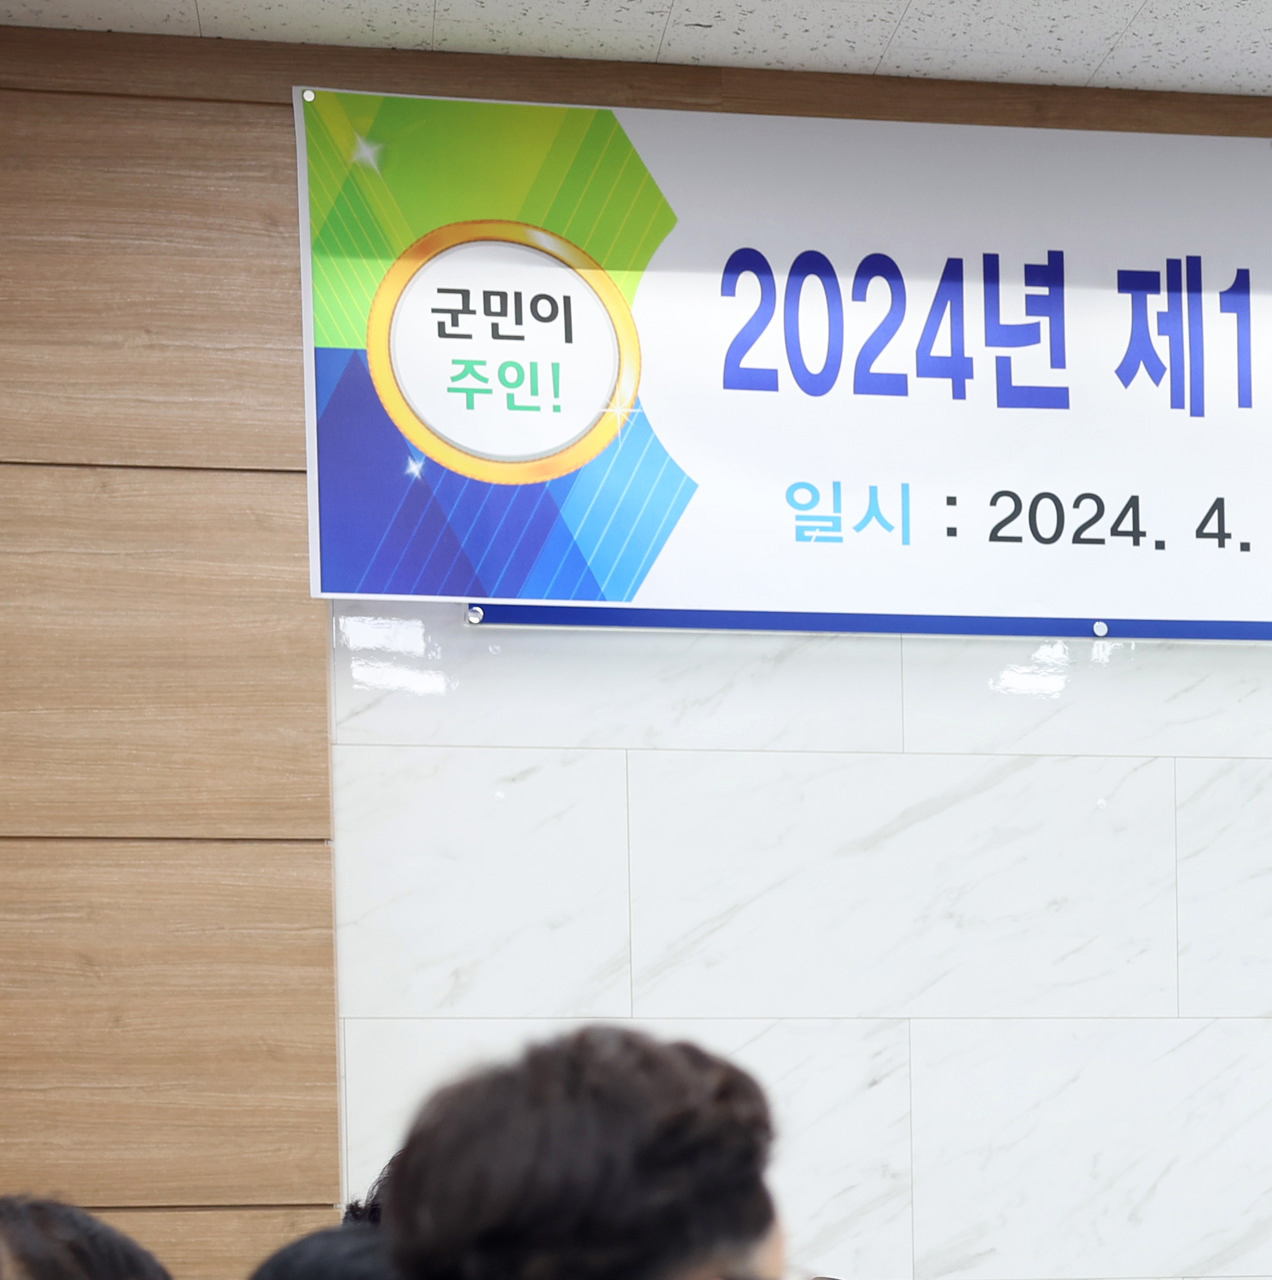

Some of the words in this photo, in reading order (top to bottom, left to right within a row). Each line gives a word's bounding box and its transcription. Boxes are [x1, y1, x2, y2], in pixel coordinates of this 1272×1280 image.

[430, 287, 574, 345] 군민이
[720, 247, 1071, 410] 2024년
[446, 358, 562, 413] 주인!
[784, 480, 912, 546] 일시
[988, 489, 1166, 551] 2024.
[1195, 496, 1252, 553] 4.
